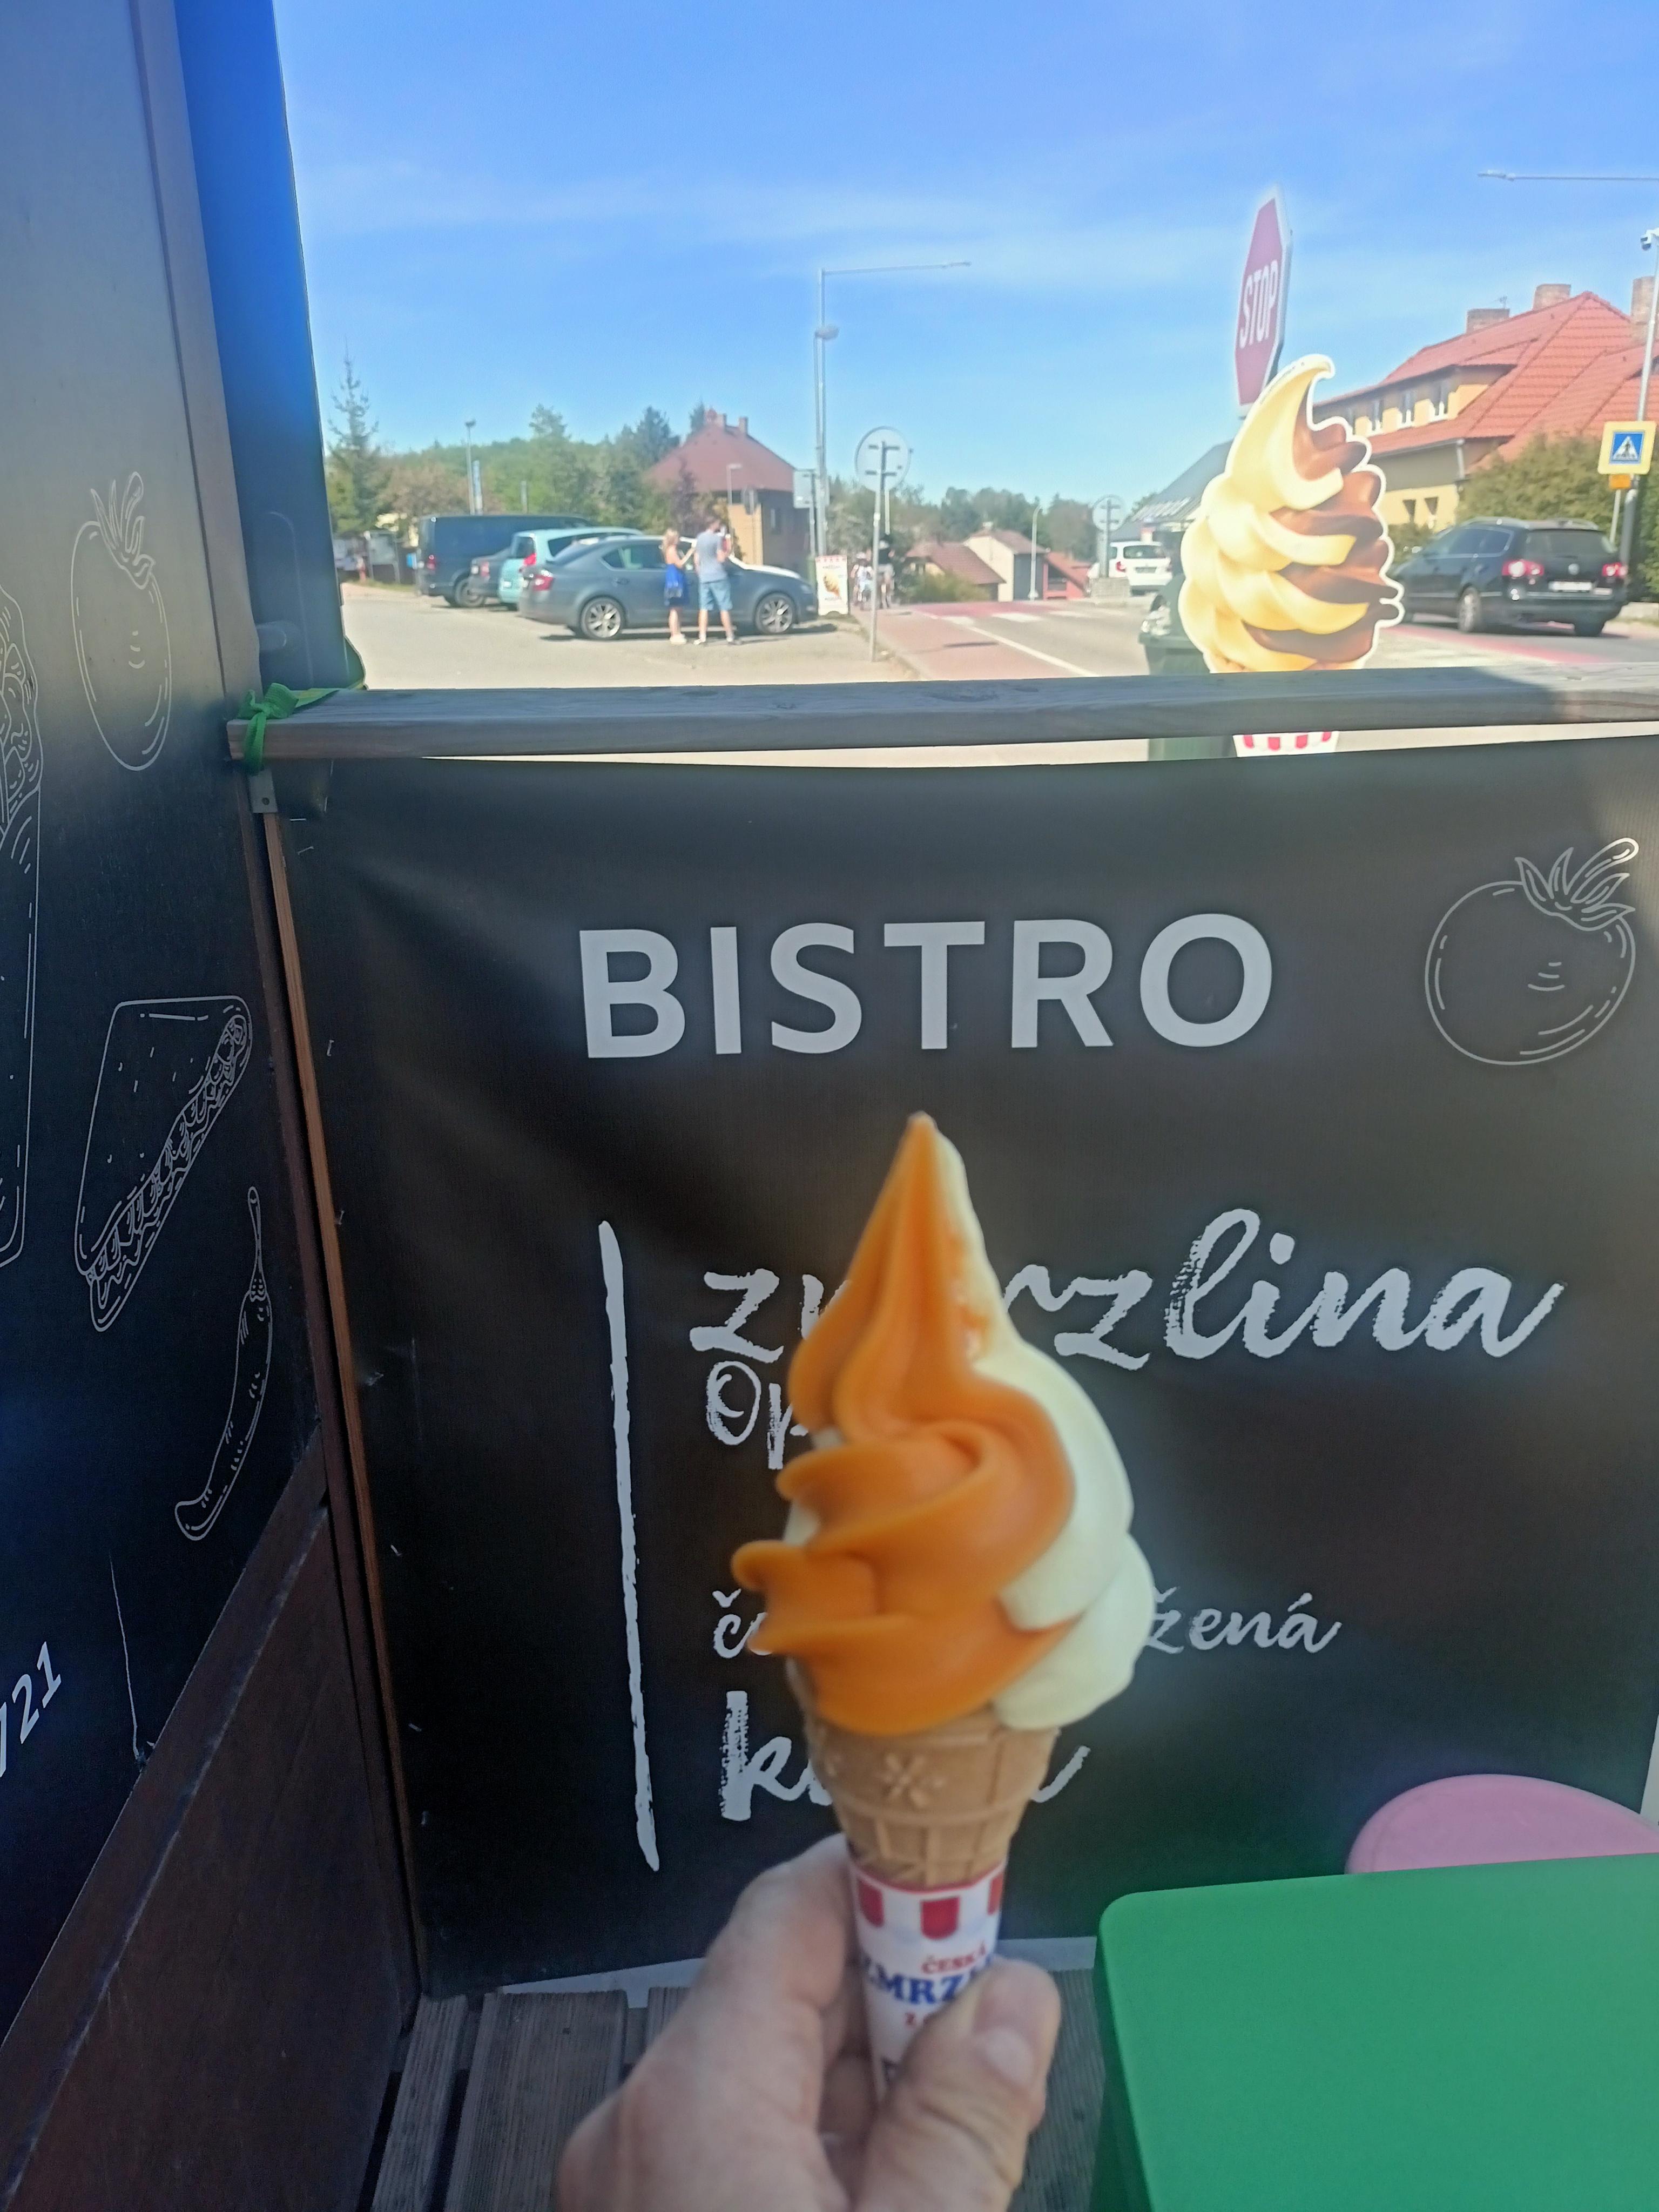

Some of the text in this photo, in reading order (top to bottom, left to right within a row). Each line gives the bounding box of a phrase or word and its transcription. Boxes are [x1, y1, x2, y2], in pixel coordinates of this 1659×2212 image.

[1239, 259, 1278, 348] STOP
[579, 913, 1273, 1058] BISTRO
[689, 1208, 1565, 1372] zrzlina
